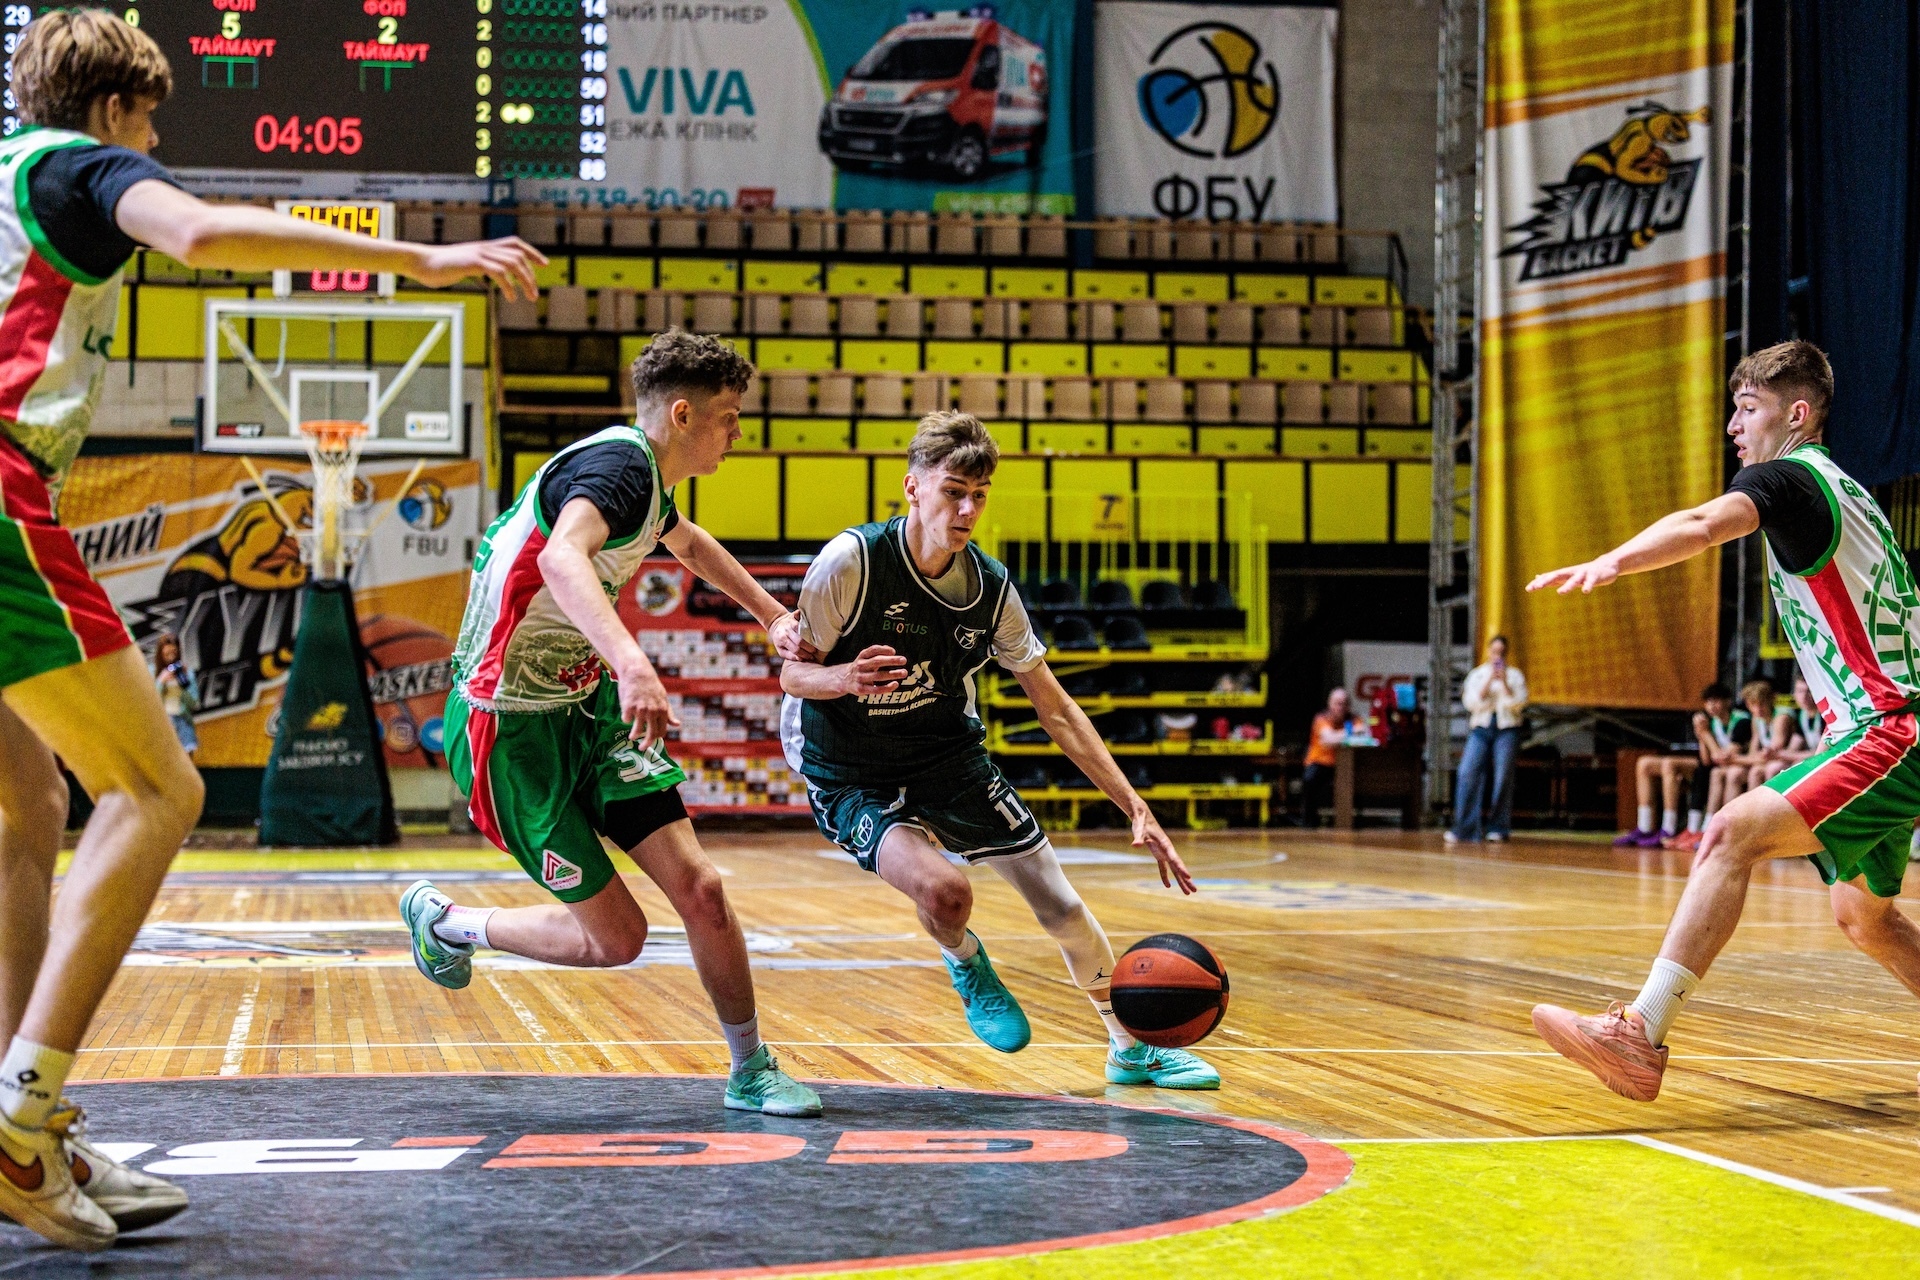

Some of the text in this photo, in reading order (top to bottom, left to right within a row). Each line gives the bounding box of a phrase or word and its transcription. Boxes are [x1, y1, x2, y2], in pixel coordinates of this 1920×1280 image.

[4, 5, 31, 26] 29
[221, 11, 242, 40] 5
[662, 4, 768, 24] ПАРТНЕР
[377, 17, 399, 45] 2
[476, 19, 608, 45] 2 16
[189, 34, 277, 58] ТАЙМАУТ
[343, 39, 430, 62] ТАЙМАУТ
[475, 46, 492, 69] 0
[475, 73, 492, 96] 0
[617, 66, 756, 117] VIVA
[475, 101, 605, 126] 2 51
[254, 115, 364, 155] 04:05
[475, 128, 607, 154] 3 52
[608, 119, 668, 142] ЕЖА
[475, 155, 491, 179] 5
[1154, 174, 1276, 223] ФБУ
[74, 503, 162, 564] НИЙ
[403, 533, 449, 557] FBU
[882, 619, 929, 636] BIOTUS
[993, 792, 1030, 832] 11
